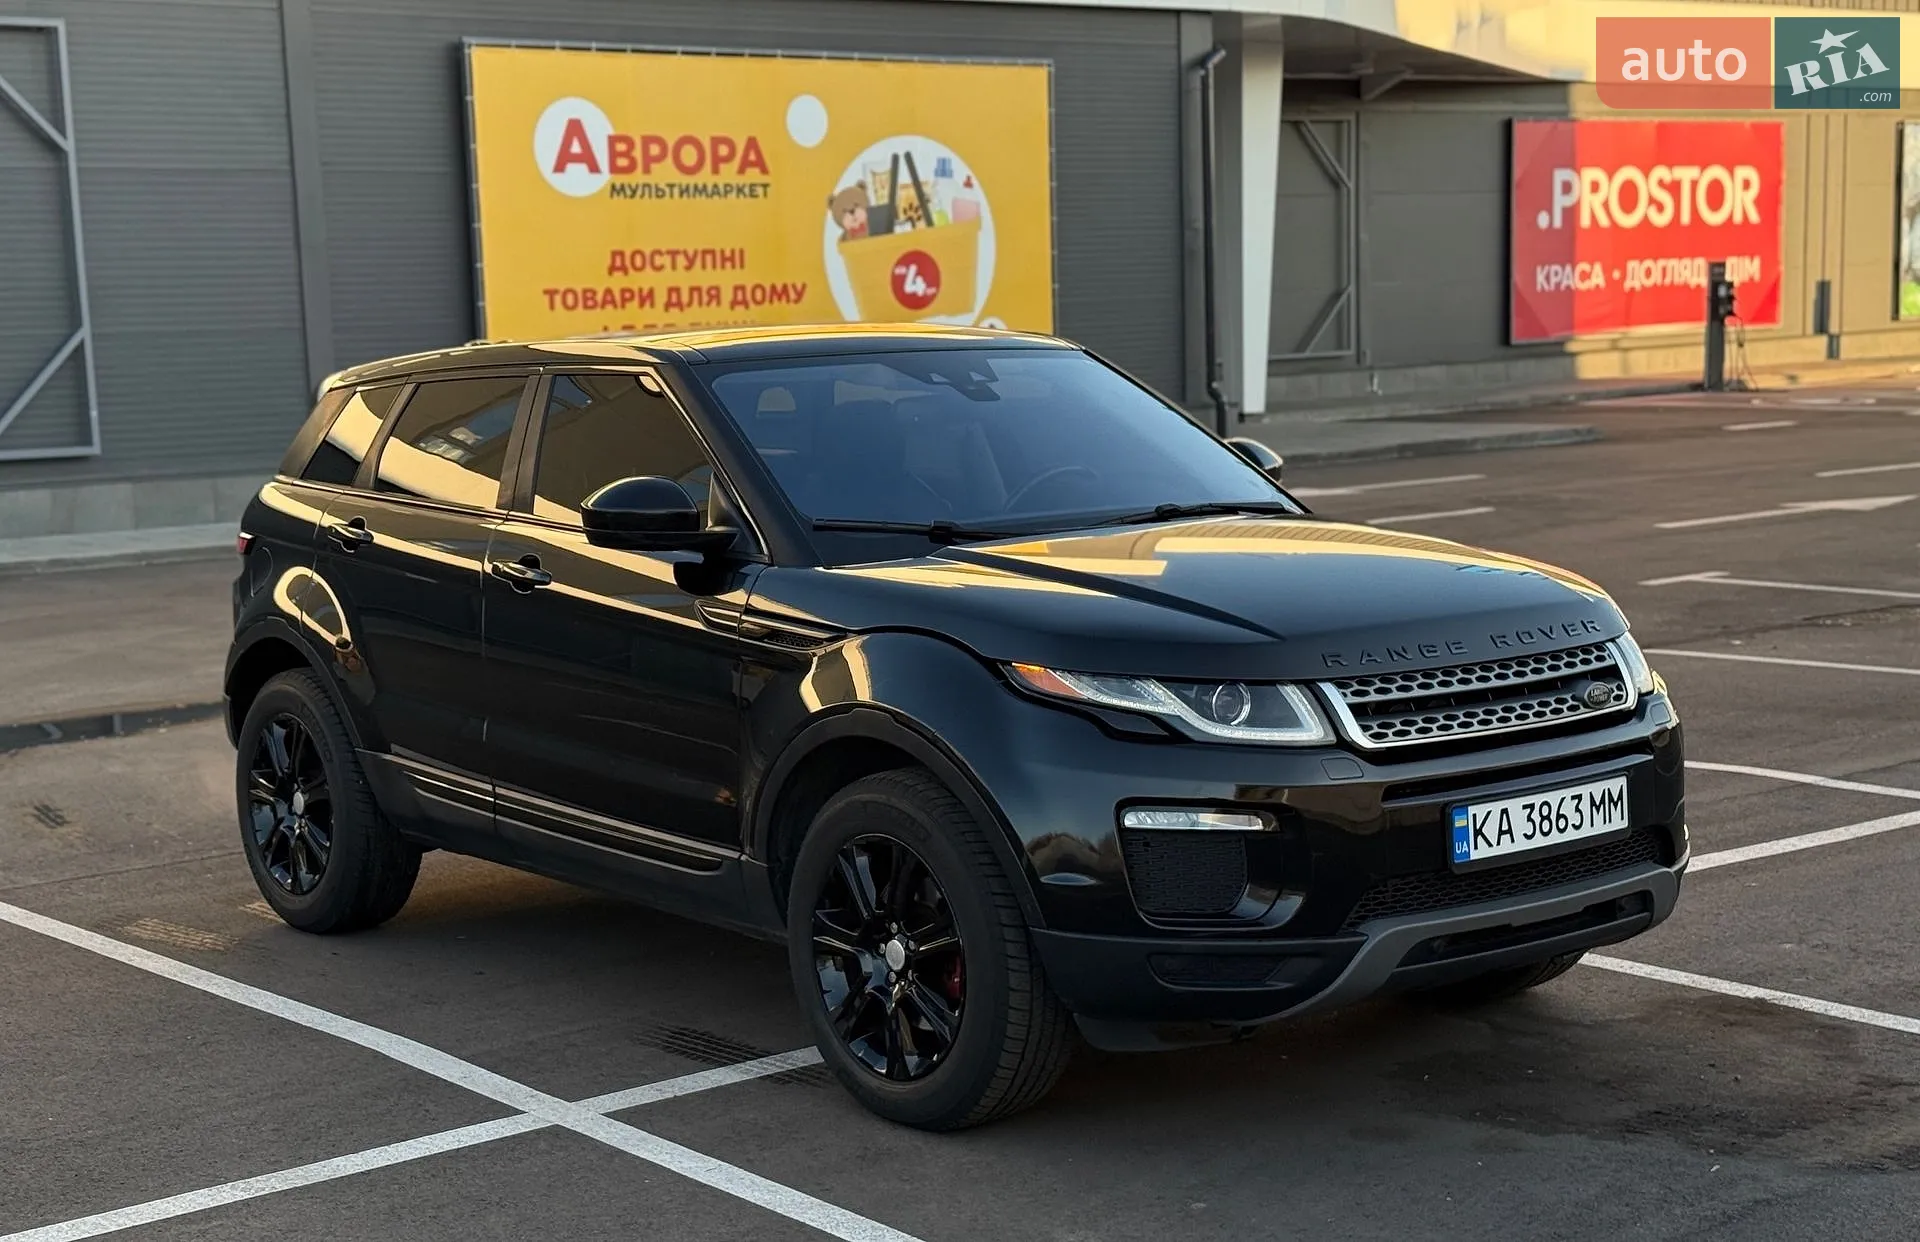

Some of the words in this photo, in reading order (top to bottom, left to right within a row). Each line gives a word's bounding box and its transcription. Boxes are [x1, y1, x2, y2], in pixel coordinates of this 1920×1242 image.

[609, 183, 771, 199] МУЛЬТИМАРКЕТ
[1537, 164, 1760, 229] .PROSTOR
[607, 248, 746, 276] ДОСТУПНІ
[1536, 261, 1606, 292] КРАСА
[1624, 257, 1708, 291] ДОГЛЯД
[1725, 255, 1761, 285] ДІМ
[543, 286, 655, 311] ТОВАРИ
[664, 285, 721, 312] ДЛЯ
[730, 282, 807, 309] ДОМУ
[1321, 640, 1468, 668] RANGE
[1489, 619, 1600, 649] ROVER
[1472, 807, 1515, 850] KA
[1522, 793, 1584, 840] 3863
[1589, 785, 1624, 828] MM
[1455, 841, 1469, 854] UA
